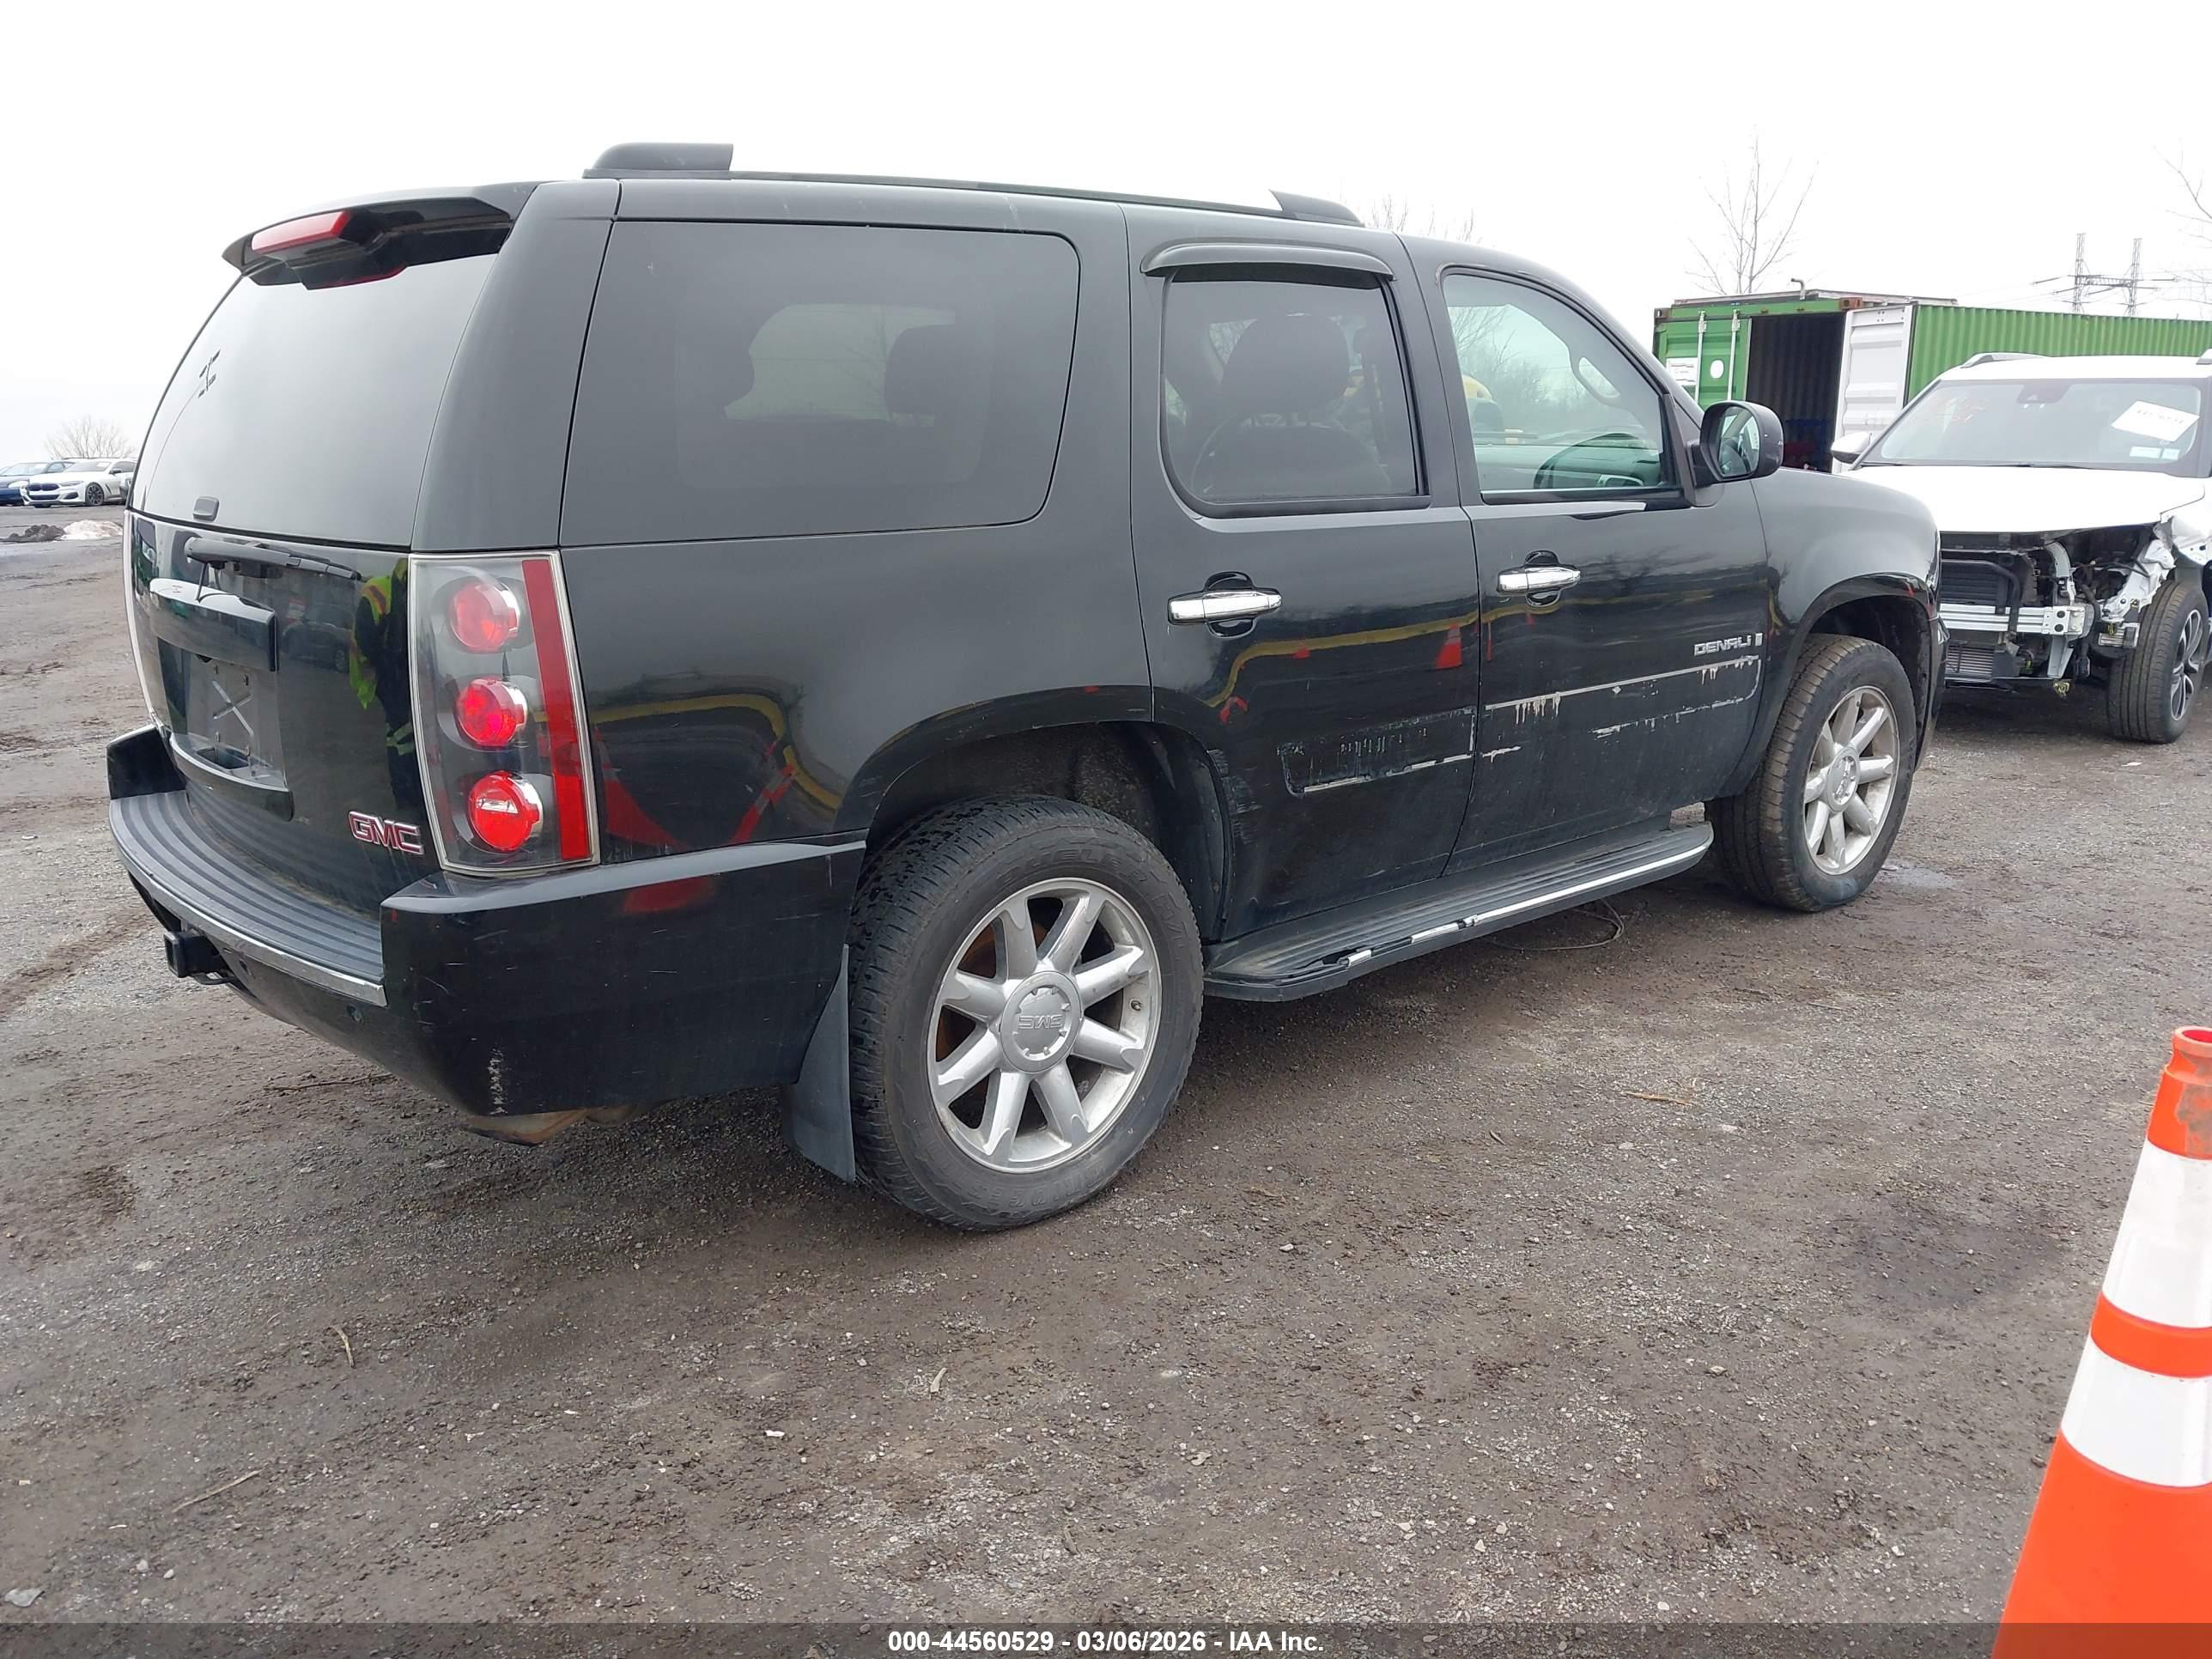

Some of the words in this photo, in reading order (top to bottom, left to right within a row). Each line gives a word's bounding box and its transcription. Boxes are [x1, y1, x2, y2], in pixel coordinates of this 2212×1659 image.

[1693, 635, 1752, 656] DENALI
[348, 811, 424, 854] GMC
[1018, 1013, 1064, 1030] GMC
